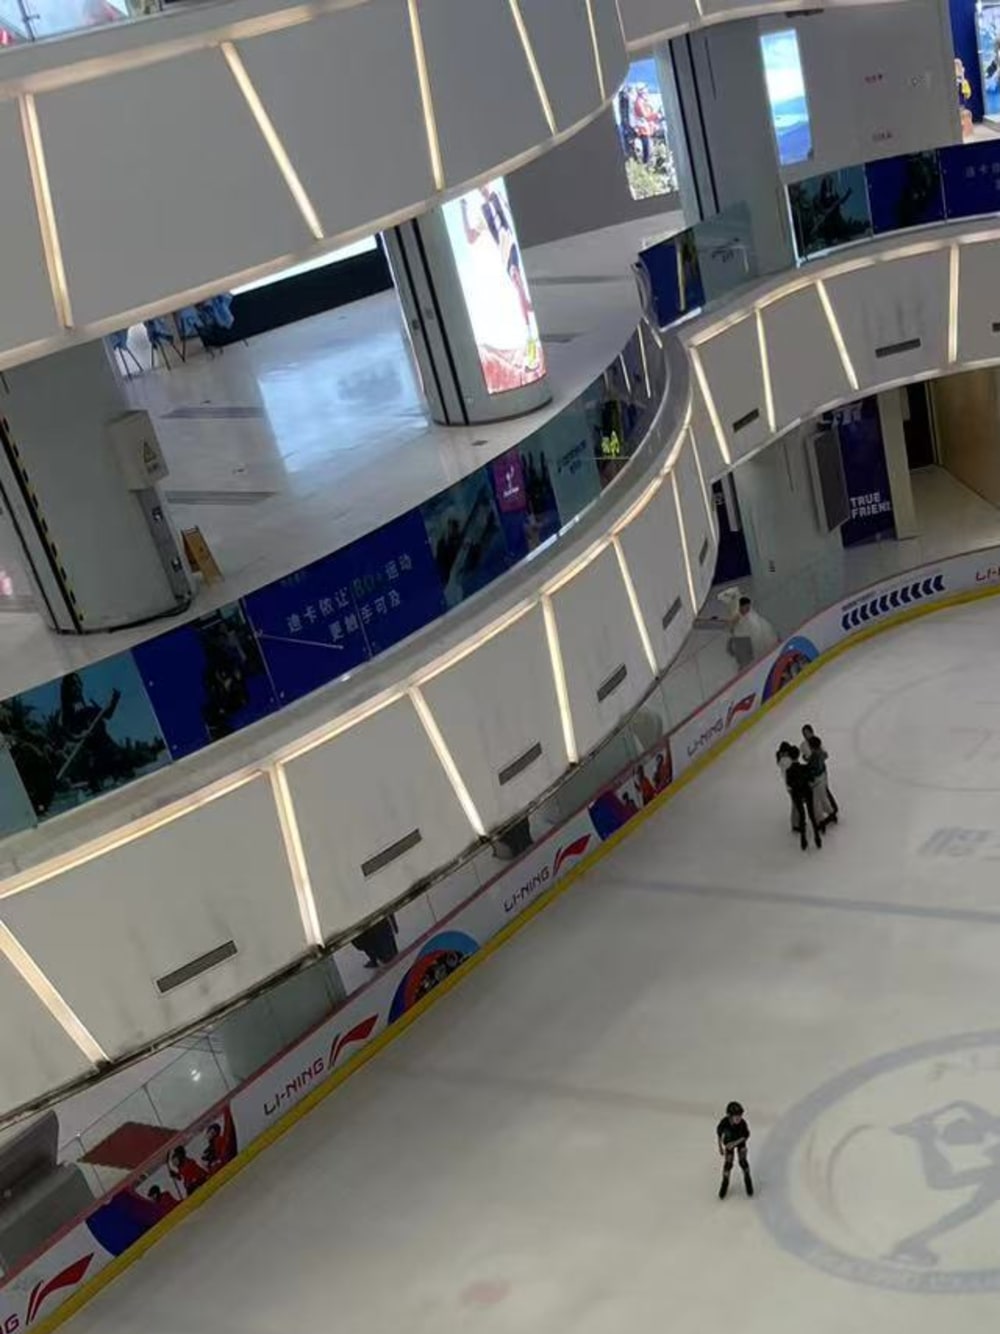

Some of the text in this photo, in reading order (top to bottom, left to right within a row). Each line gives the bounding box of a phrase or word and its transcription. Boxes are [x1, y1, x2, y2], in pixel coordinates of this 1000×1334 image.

[850, 491, 881, 508] TRUE
[328, 589, 401, 641] 更触手可及
[687, 718, 724, 757] LI-NING
[503, 866, 550, 913] LI-NING
[263, 1057, 324, 1116] LI-NING
